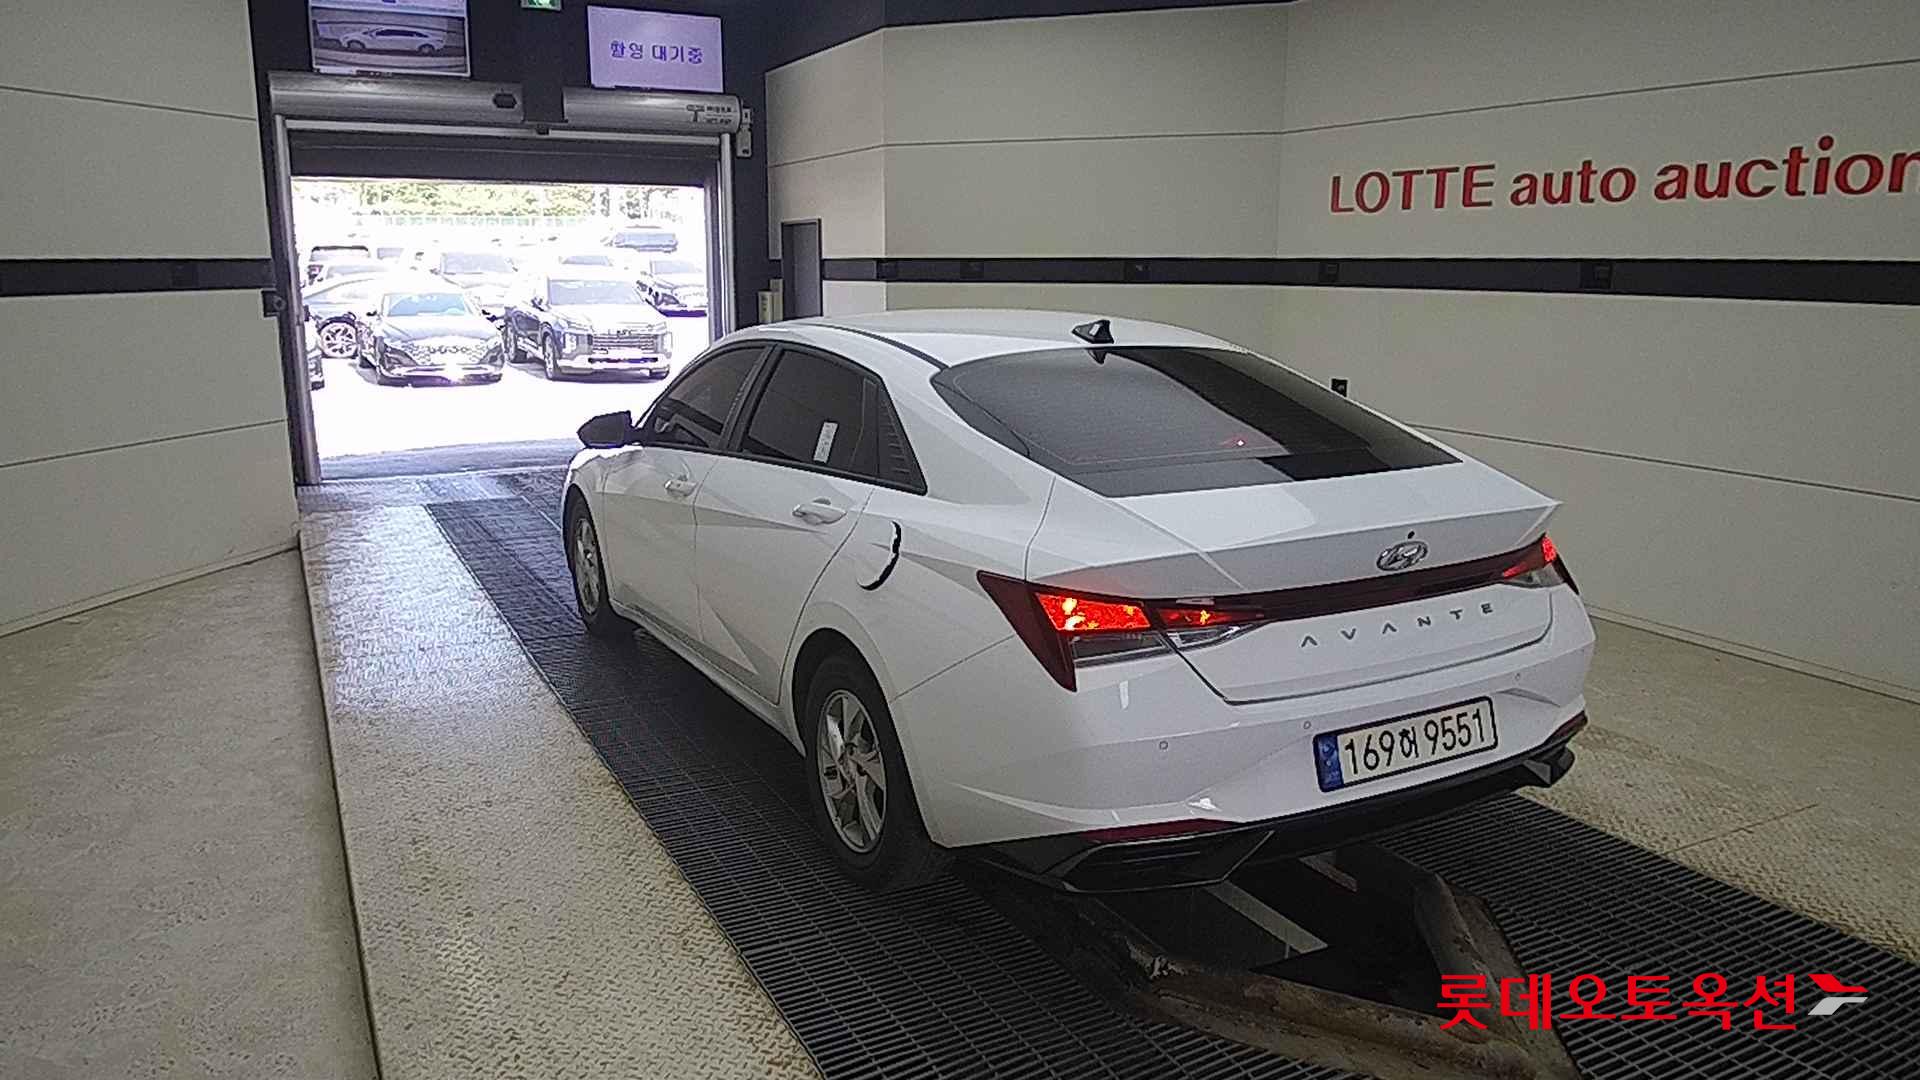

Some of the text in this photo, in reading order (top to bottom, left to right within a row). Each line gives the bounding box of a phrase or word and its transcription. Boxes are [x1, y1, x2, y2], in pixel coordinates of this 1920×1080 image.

[652, 44, 703, 64] 대기중
[1331, 164, 1496, 213] LOTTE
[1510, 160, 1637, 207] auto
[1300, 602, 1494, 648] AVANTE
[1423, 708, 1486, 756] 9551
